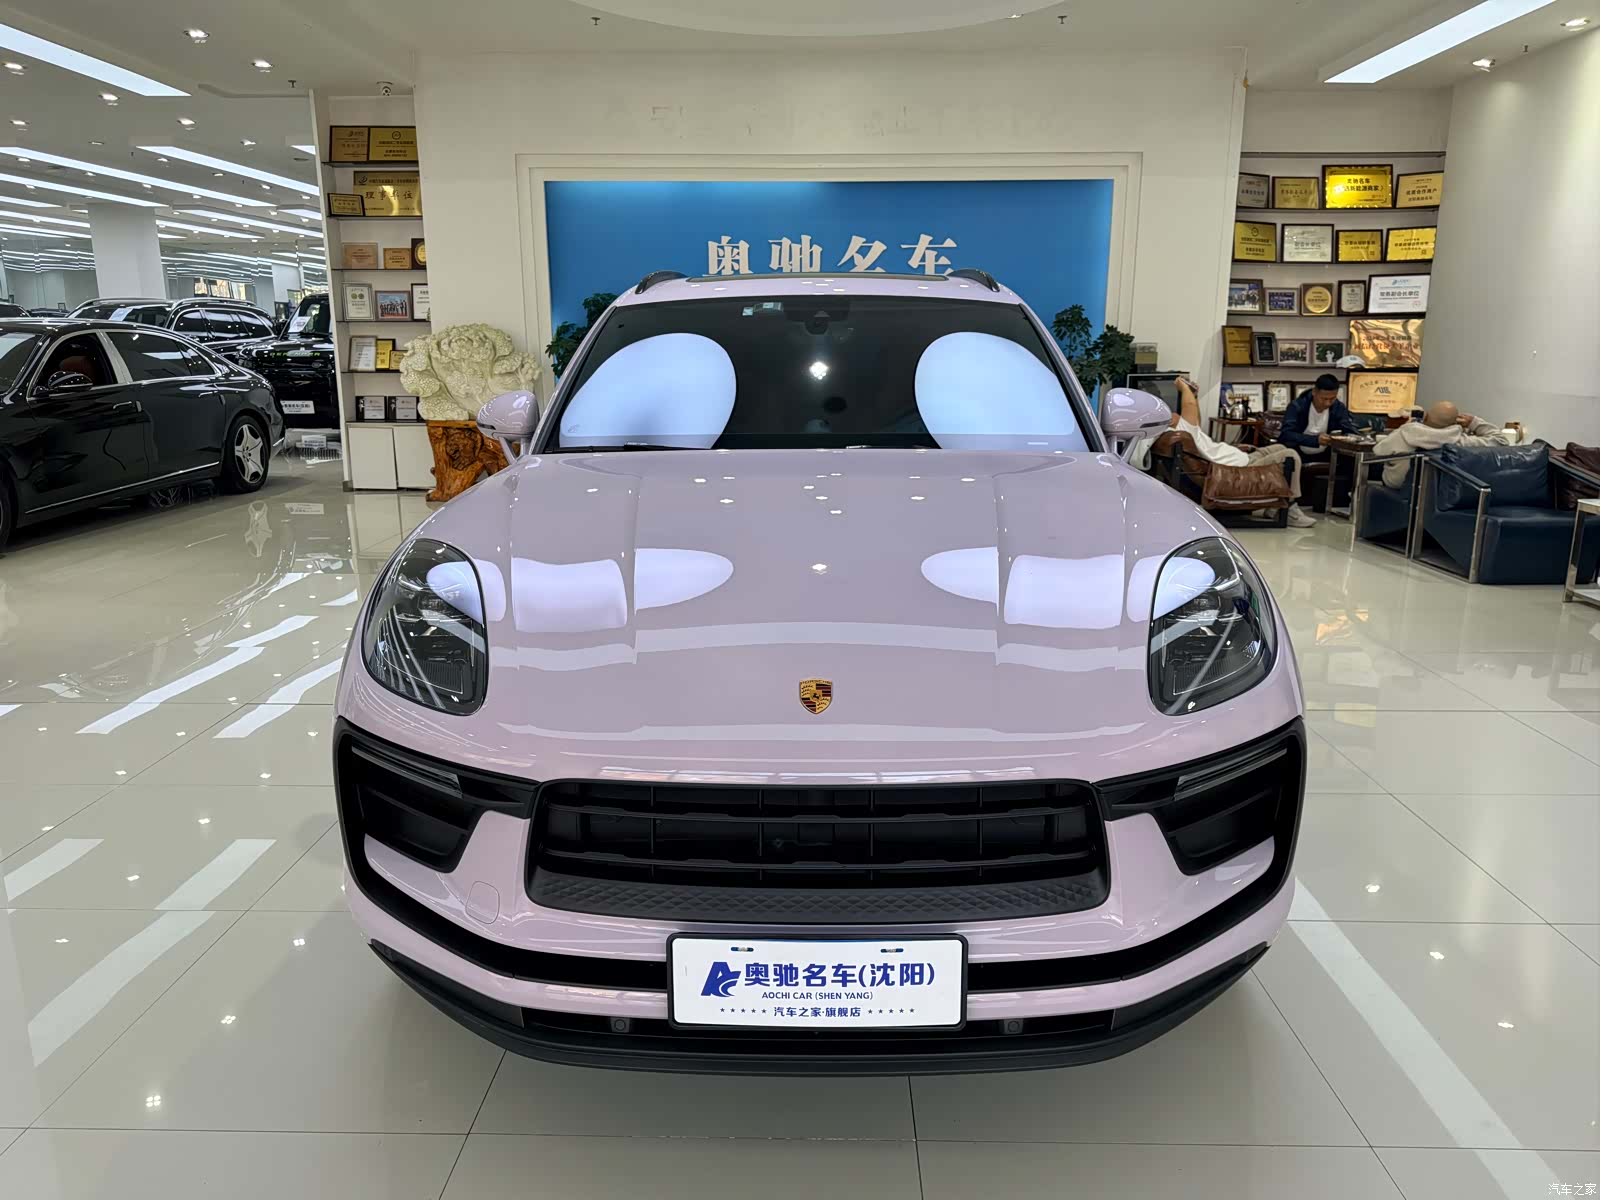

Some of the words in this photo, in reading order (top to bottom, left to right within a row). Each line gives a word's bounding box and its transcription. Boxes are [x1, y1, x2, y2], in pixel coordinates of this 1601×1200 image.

[744, 962, 935, 988] 奥驰名车(沈阳)
[762, 991, 791, 1000] AOCHI
[793, 991, 813, 1000] CAR
[815, 991, 842, 1001] (SHEN
[844, 991, 873, 1001] YANG)
[774, 1006, 861, 1018] 汽车之家·旗舰店
